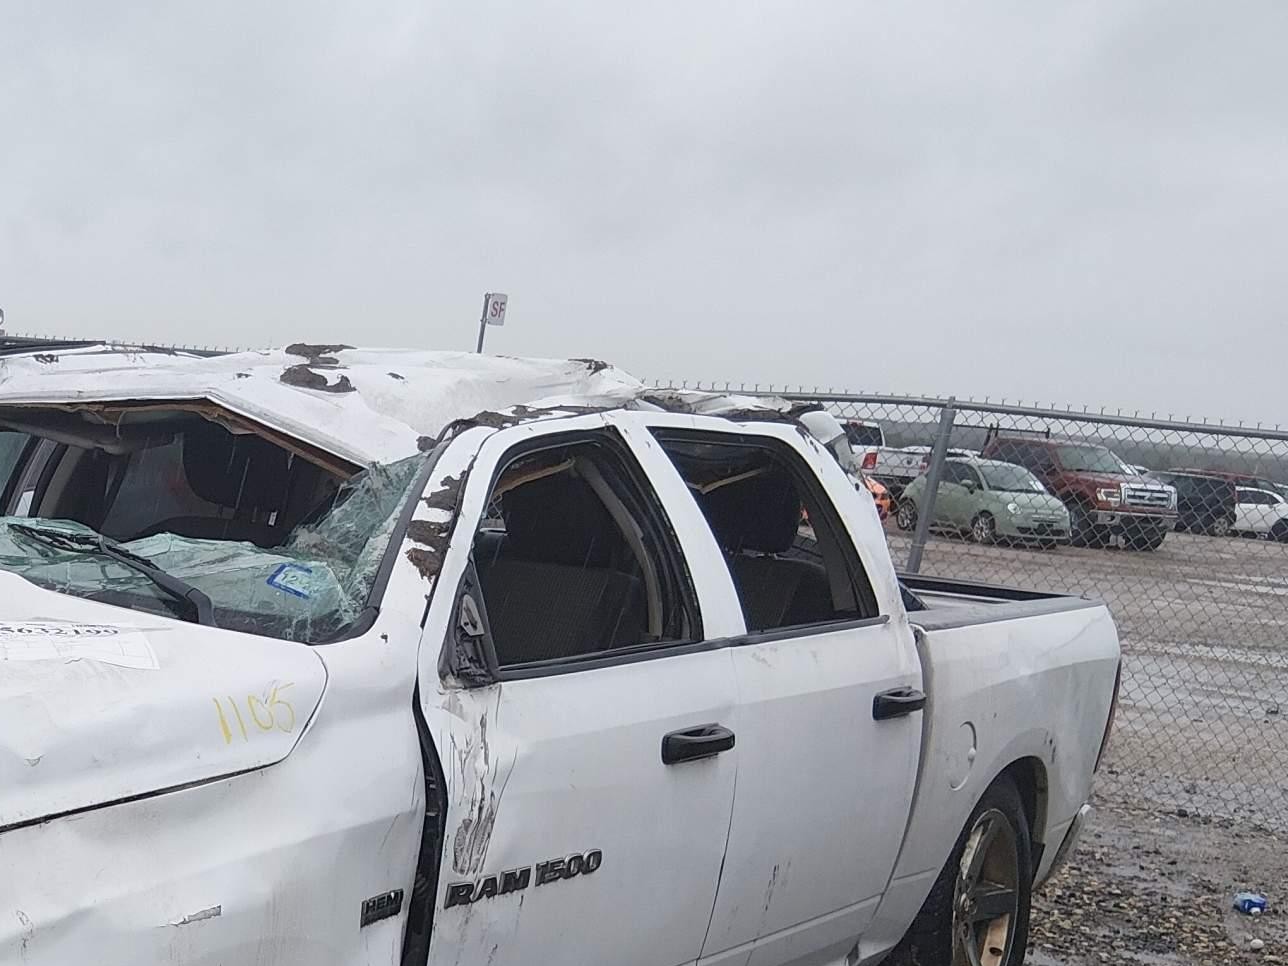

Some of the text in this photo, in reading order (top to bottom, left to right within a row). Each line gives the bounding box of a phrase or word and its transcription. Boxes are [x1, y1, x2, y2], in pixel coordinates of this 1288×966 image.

[491, 301, 506, 318] SF
[211, 682, 295, 744] 1105
[444, 849, 603, 909] RAM 1500
